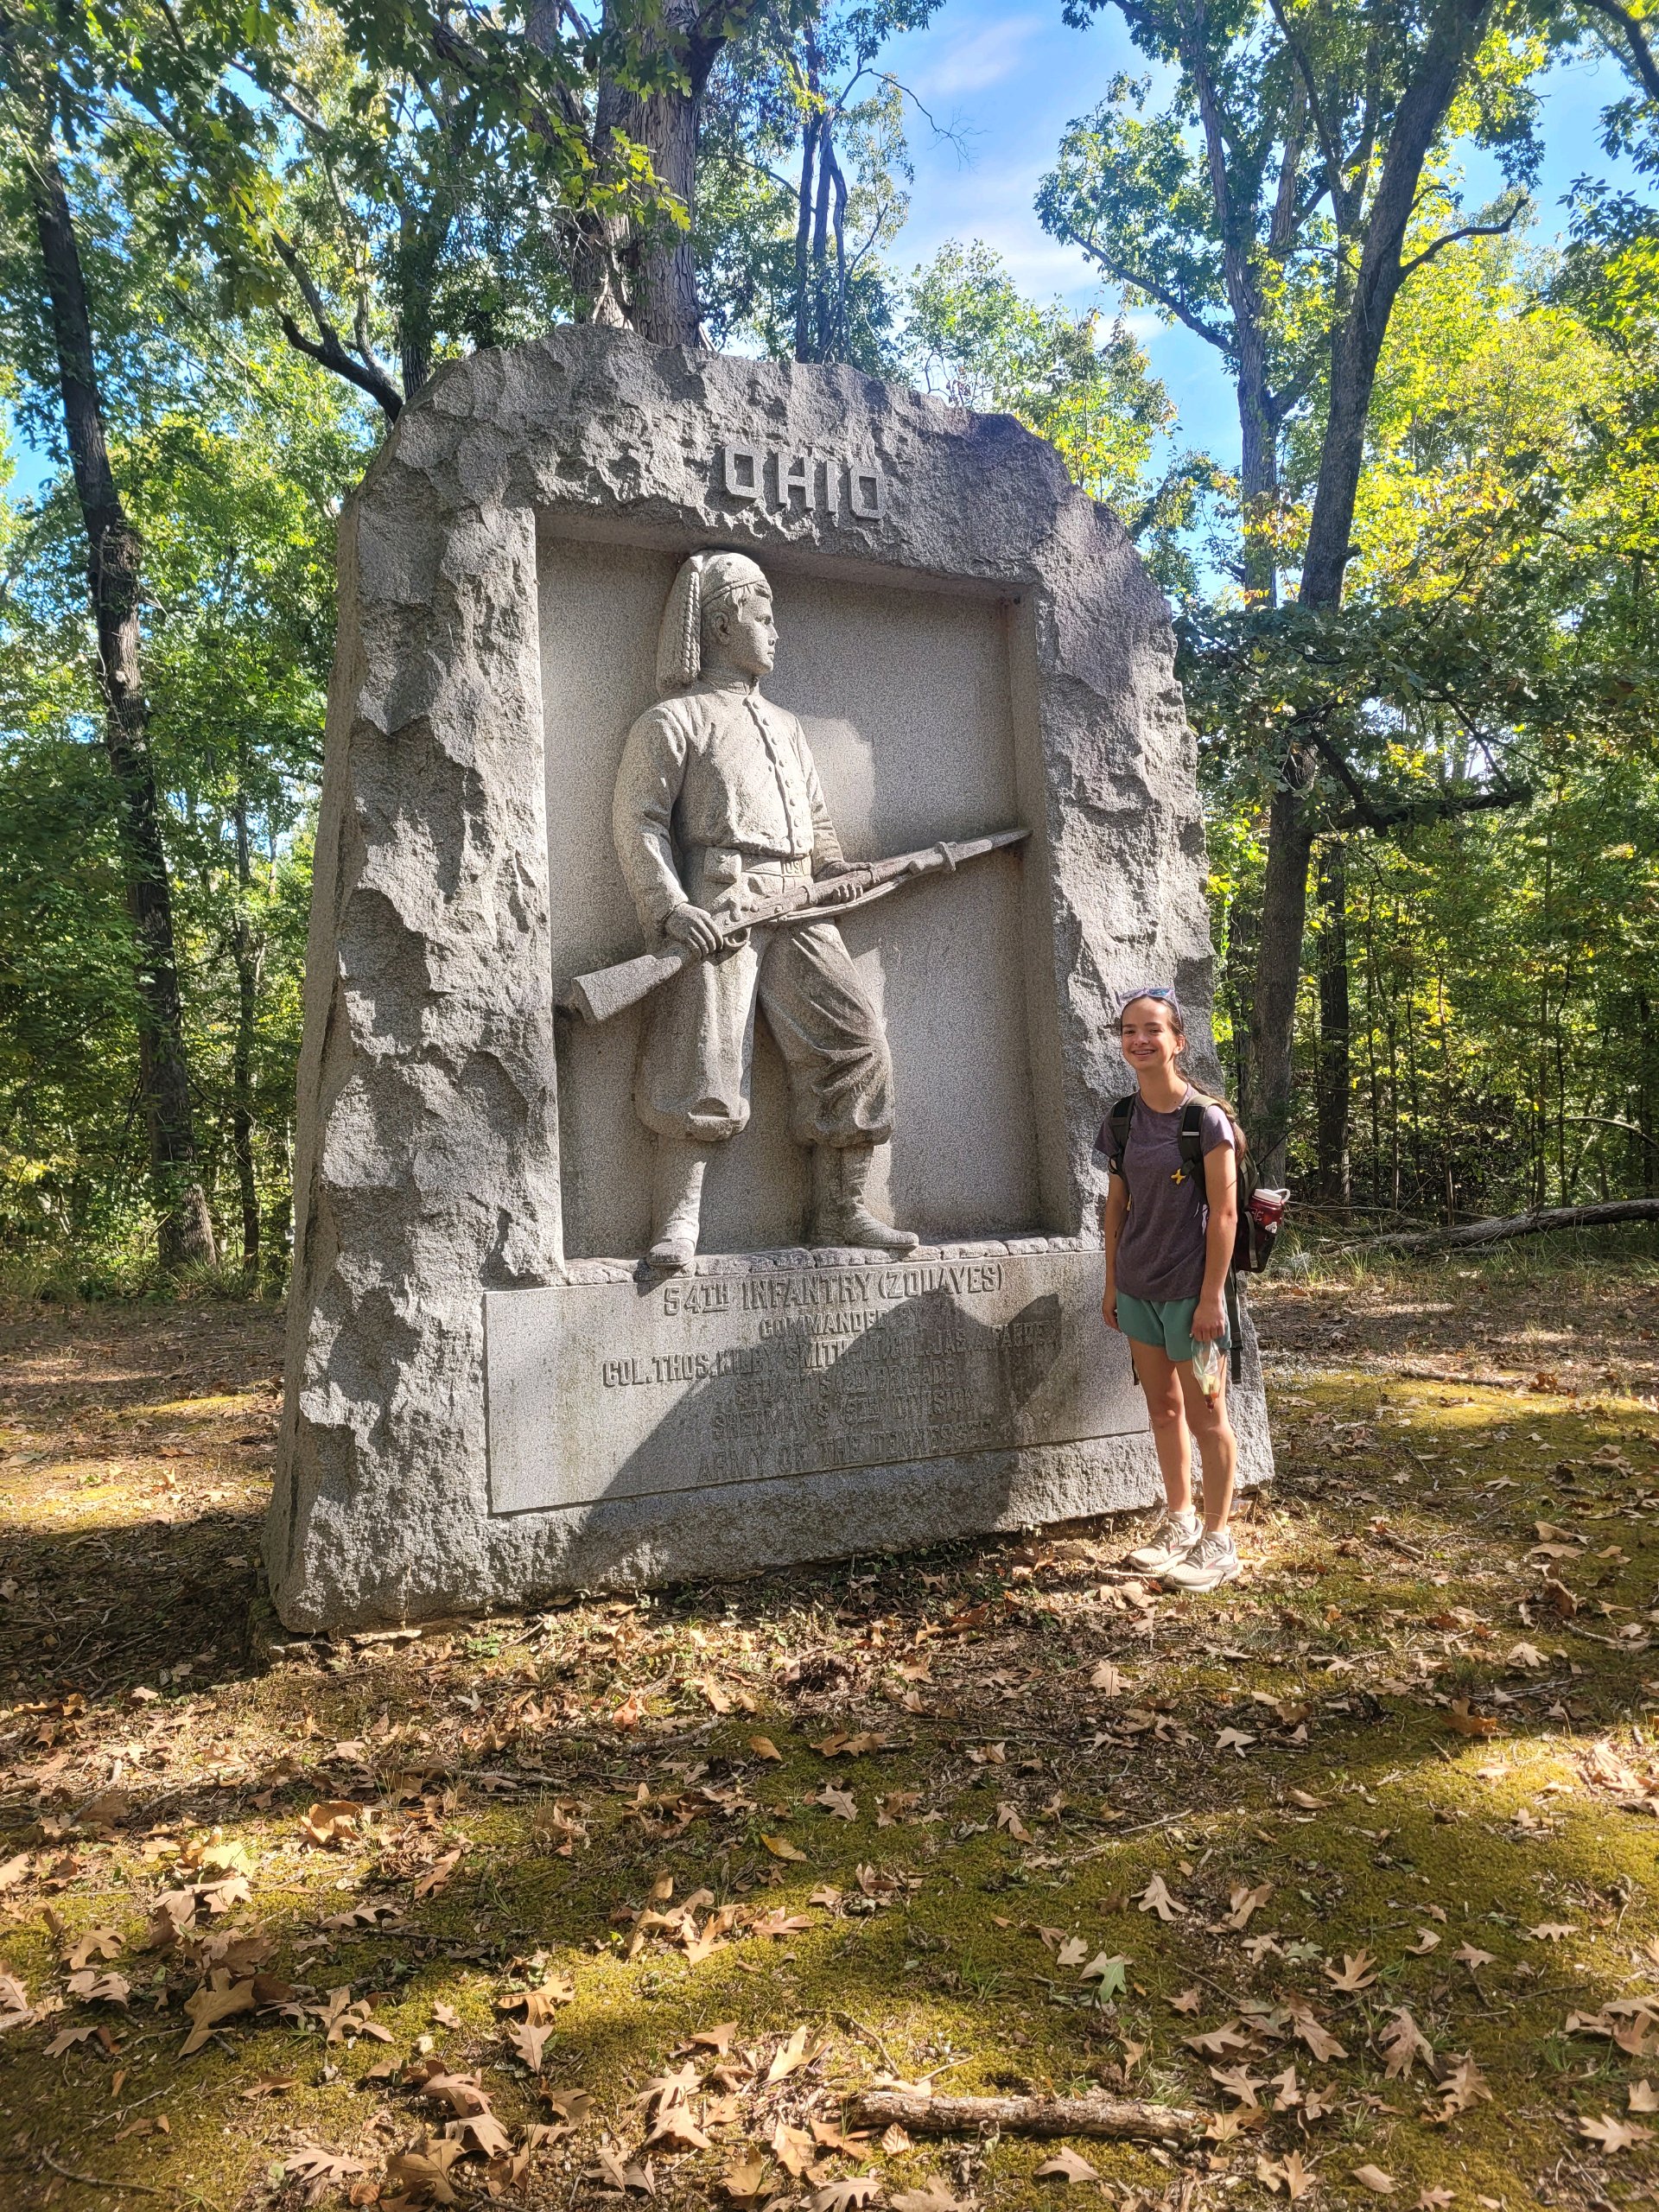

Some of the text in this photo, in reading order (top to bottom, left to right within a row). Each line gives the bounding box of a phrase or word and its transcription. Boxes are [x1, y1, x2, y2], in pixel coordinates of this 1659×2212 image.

[722, 444, 887, 520] OHIO
[664, 1262, 1006, 1317] 54TH INFANTRY (ZOUAVES)
[759, 1306, 922, 1339] COMMANDED BY
[893, 1387, 976, 1420] DIVISION
[696, 1420, 993, 1483] ARMY OF THE TENNESSEE
